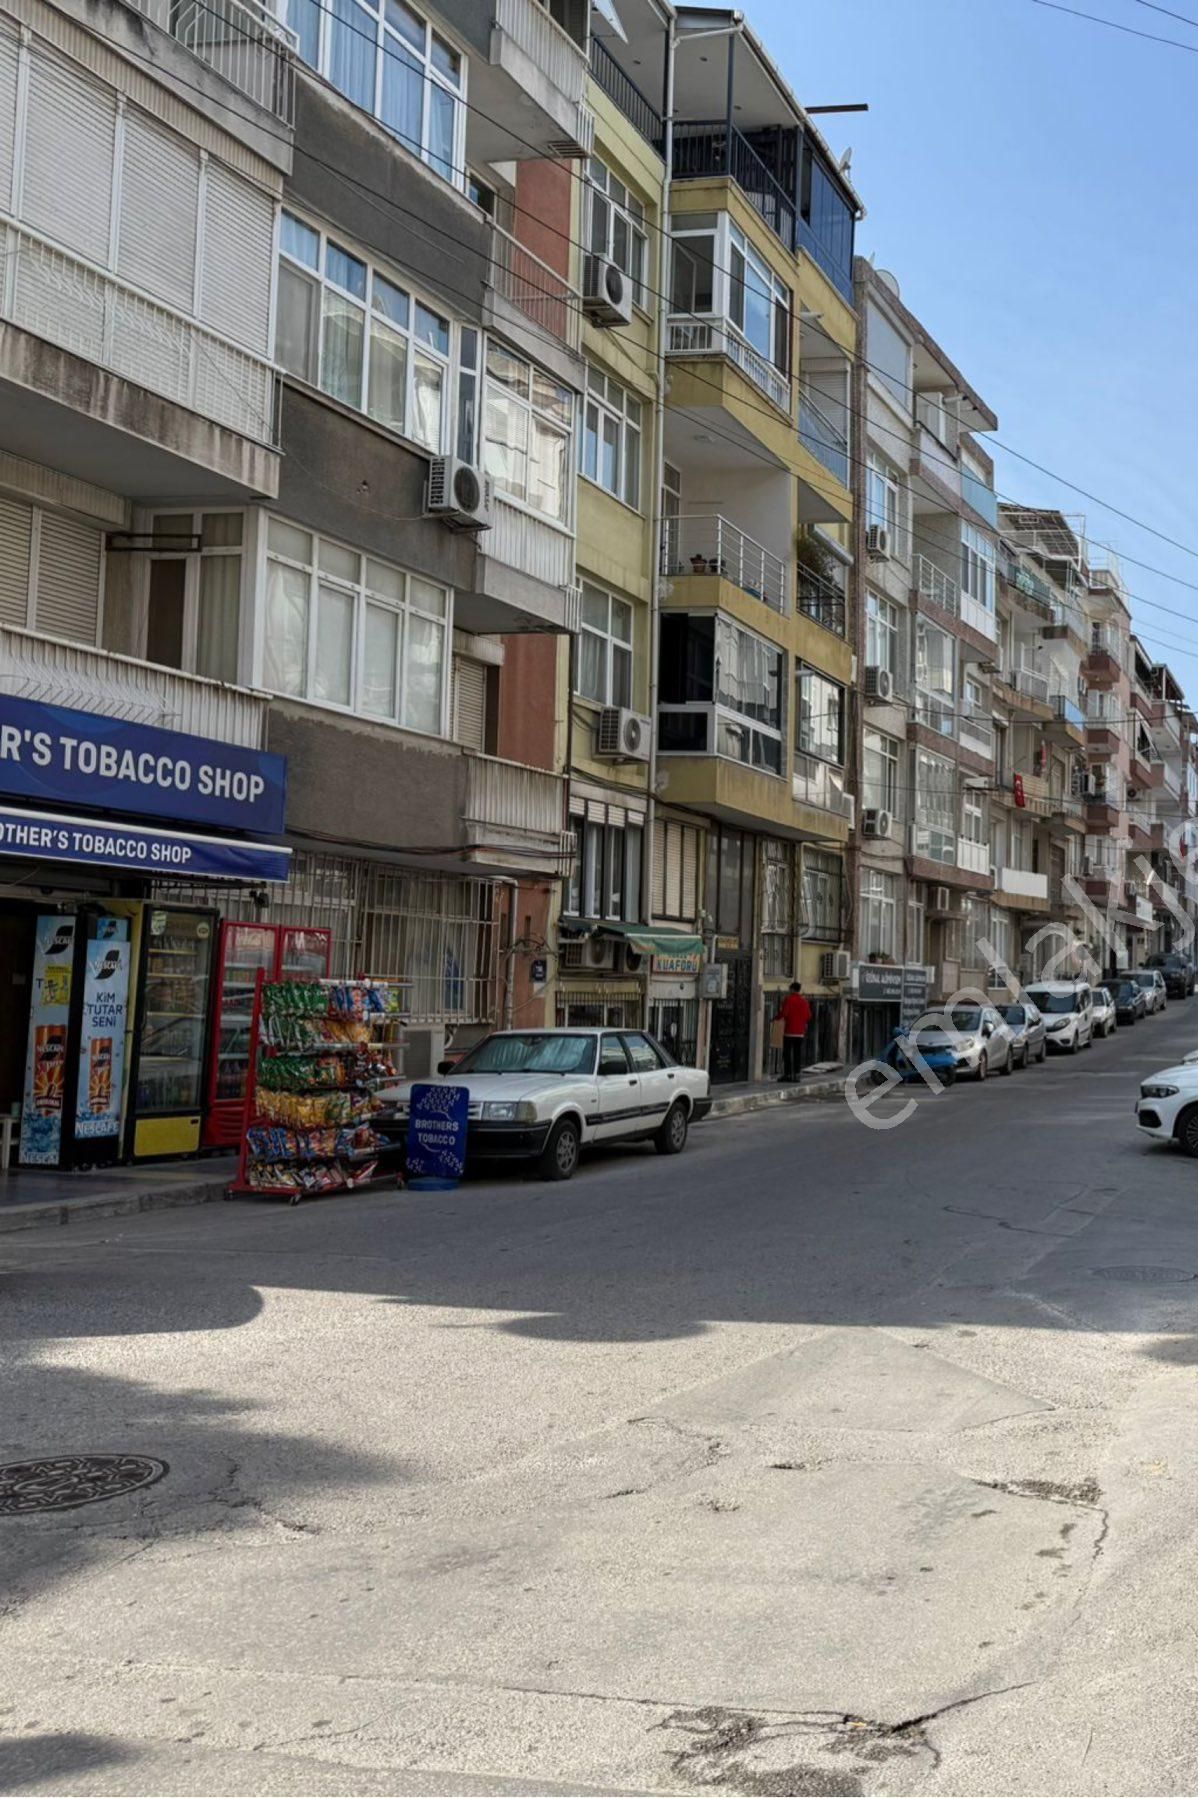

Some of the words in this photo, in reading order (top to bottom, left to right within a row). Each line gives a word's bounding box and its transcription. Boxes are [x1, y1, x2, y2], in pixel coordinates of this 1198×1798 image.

[60, 737, 191, 790] TOBACCO
[198, 765, 265, 803] SHOP
[73, 833, 146, 860] TOBACCO
[151, 843, 192, 864] SHOP
[87, 1004, 123, 1015] TUTAR
[415, 1119, 459, 1131] BROTHERS
[417, 1132, 456, 1145] TOBACCO
